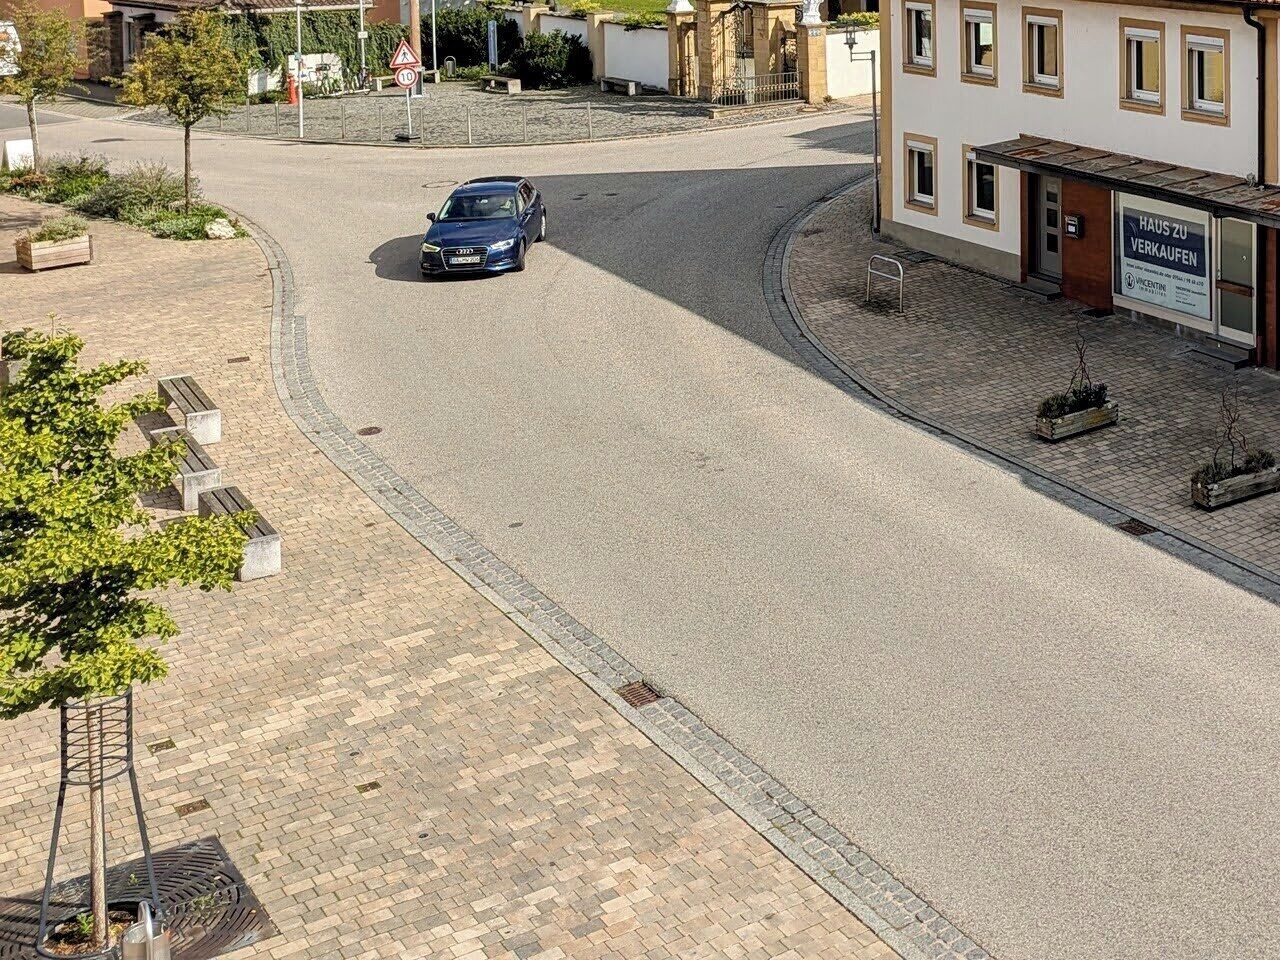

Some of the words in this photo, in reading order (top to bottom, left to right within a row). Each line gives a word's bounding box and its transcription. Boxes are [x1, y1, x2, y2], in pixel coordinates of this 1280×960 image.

[401, 72, 413, 82] 10
[1139, 216, 1170, 236] HAUS
[1172, 223, 1188, 240] ZU
[1130, 236, 1197, 267] VERKAUFEN
[1135, 276, 1167, 292] VINCENTINI
